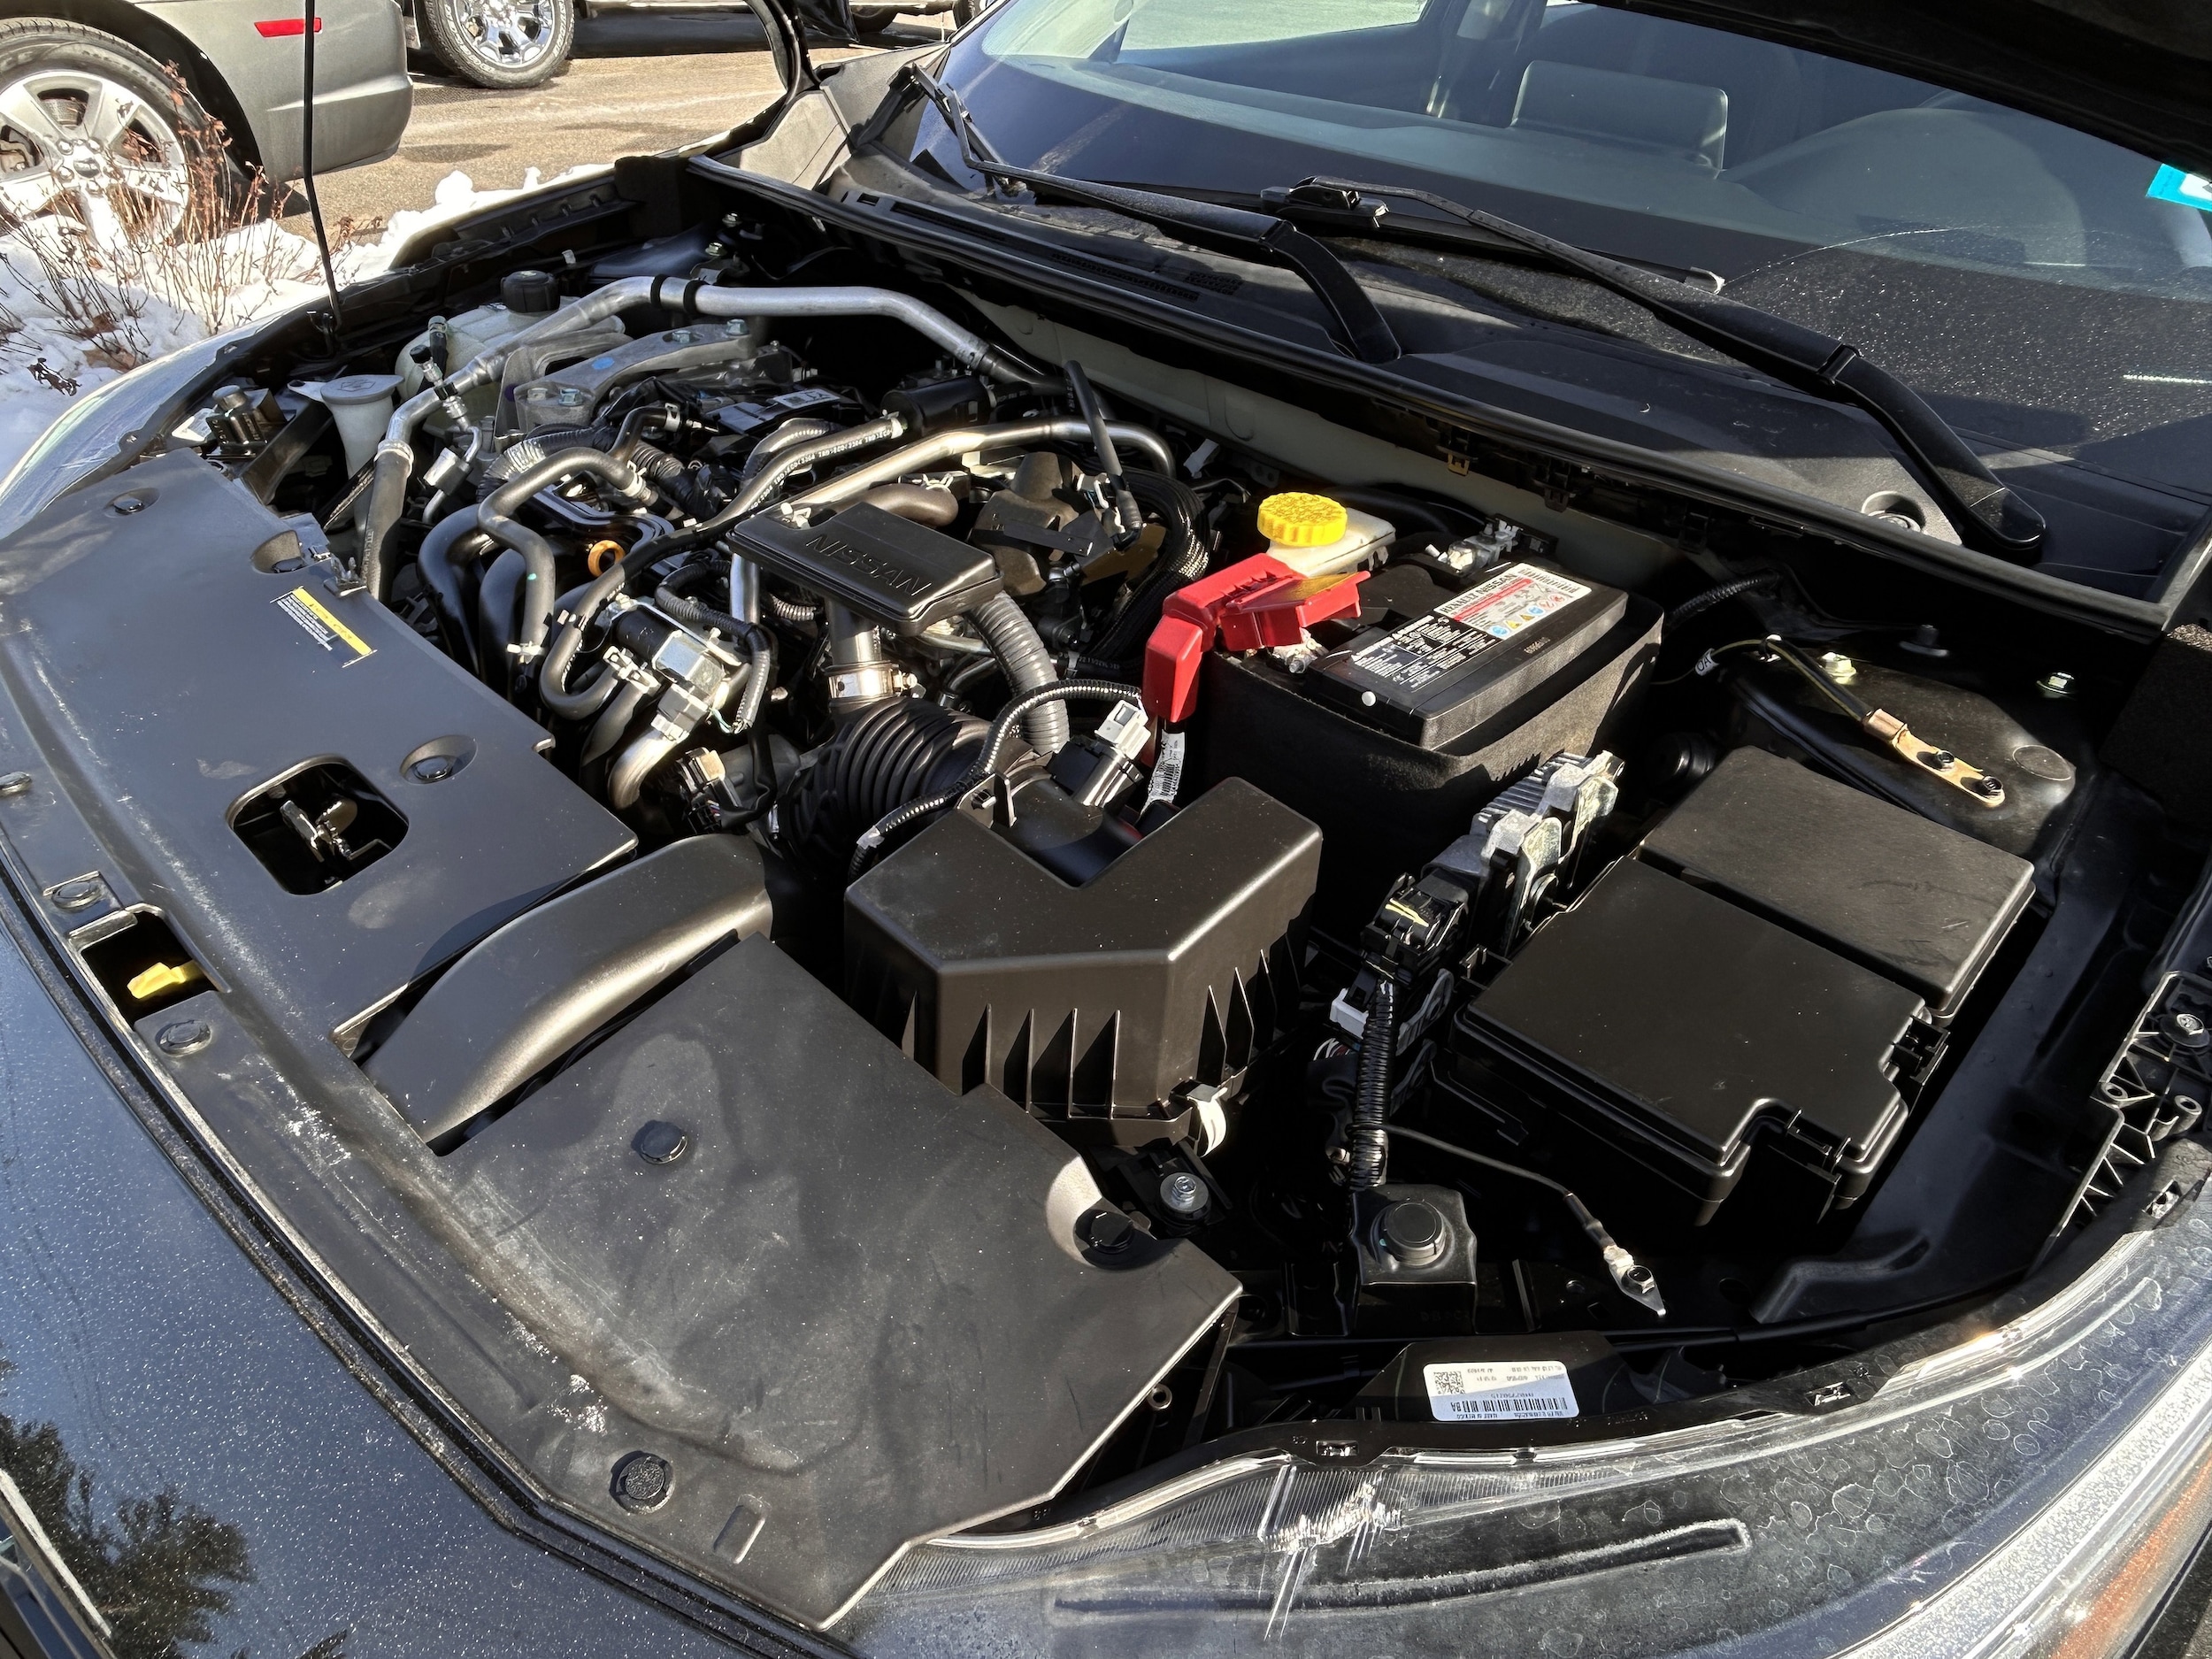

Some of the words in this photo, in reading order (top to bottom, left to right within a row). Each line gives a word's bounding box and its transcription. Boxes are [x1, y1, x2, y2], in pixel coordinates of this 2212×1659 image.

[806, 534, 932, 596] NISSAN
[1440, 593, 1479, 613] RENAULT
[1475, 573, 1517, 595] NISSAN
[1450, 1402, 1462, 1412] BA
